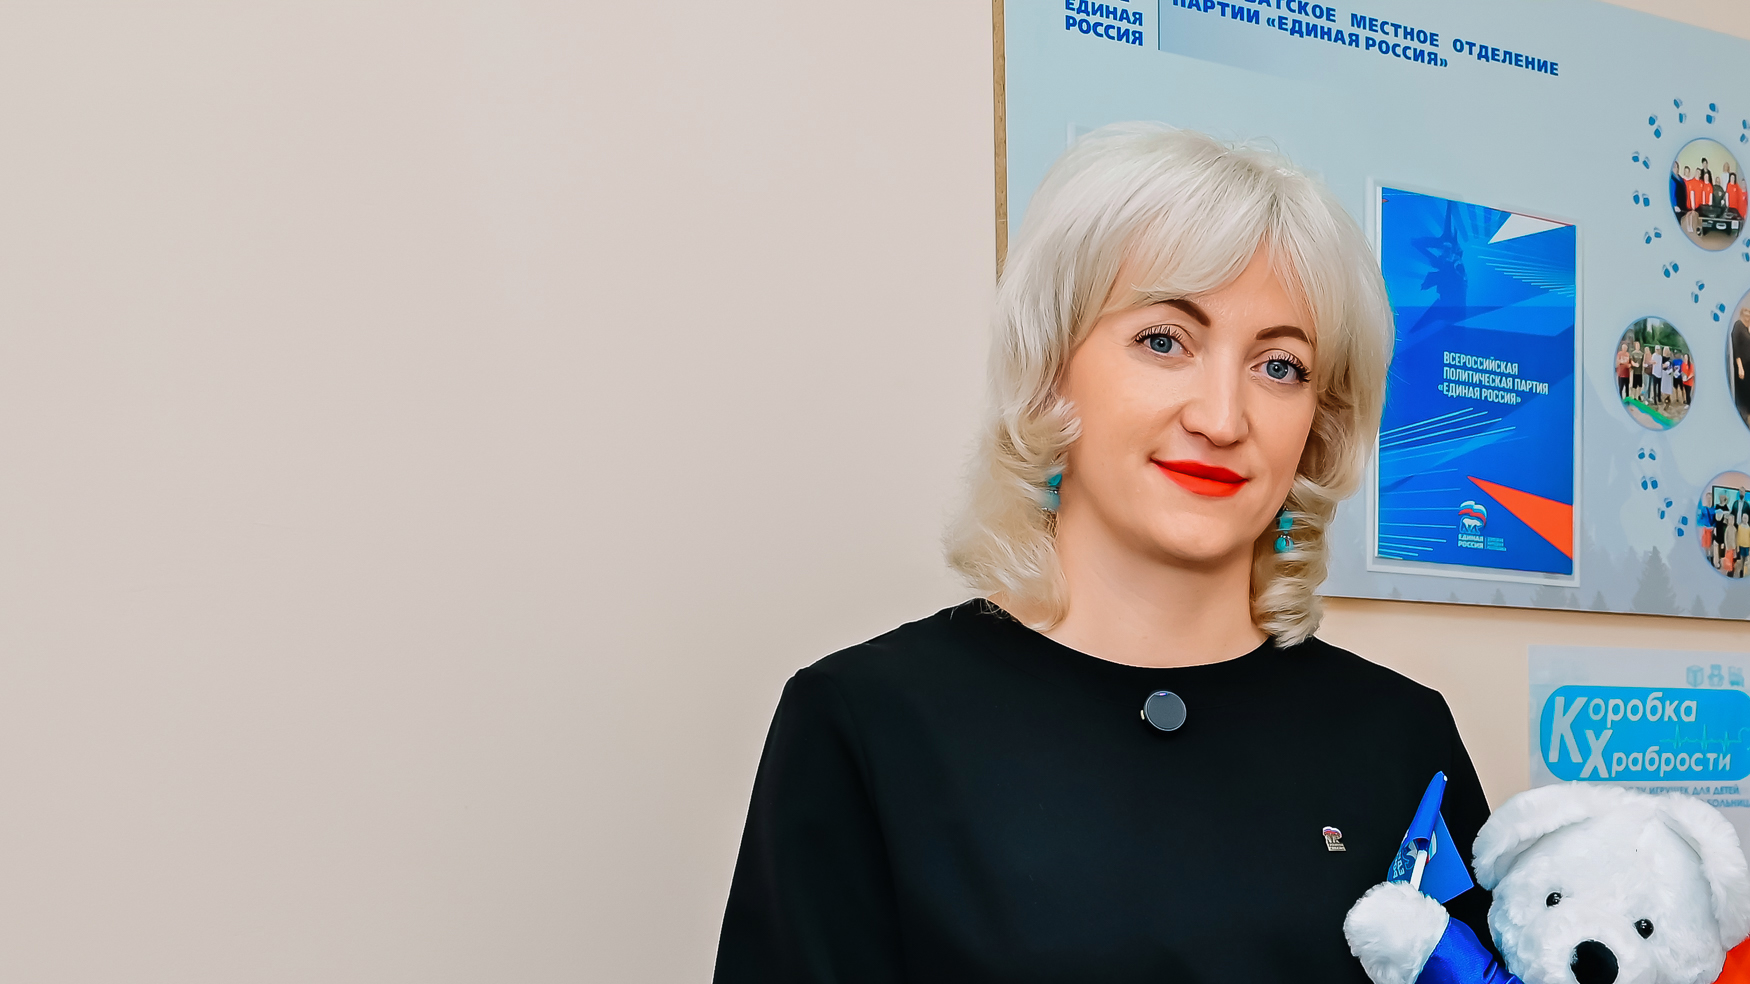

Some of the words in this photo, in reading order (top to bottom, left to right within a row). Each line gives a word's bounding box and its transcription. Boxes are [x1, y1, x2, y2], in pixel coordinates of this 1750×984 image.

[1065, 0, 1143, 26] ЕДИНАЯ
[1065, 15, 1143, 46] РОССИЯ
[1245, 0, 1336, 23] АТСКОЕ
[1350, 13, 1439, 48] МЕСТНОЕ
[1452, 38, 1559, 76] ОТДЕЛЕНИЕ
[1266, 15, 1359, 48] «ЕДИНАЯ
[1365, 36, 1448, 68] РОССИЯ»
[1443, 351, 1518, 375] ВСЕРОССИЙСКАЯ
[1437, 382, 1480, 400] «ЕДИНАЯ
[1481, 388, 1522, 405] РОССИЯ»
[1443, 366, 1513, 390] ПОЛИТИЧЕСКАЯ
[1514, 378, 1549, 395] ПАРТИЯ
[1549, 691, 1697, 763] Коробка
[1579, 729, 1731, 778] Храбрости
[1692, 786, 1711, 796] ДЛЯ
